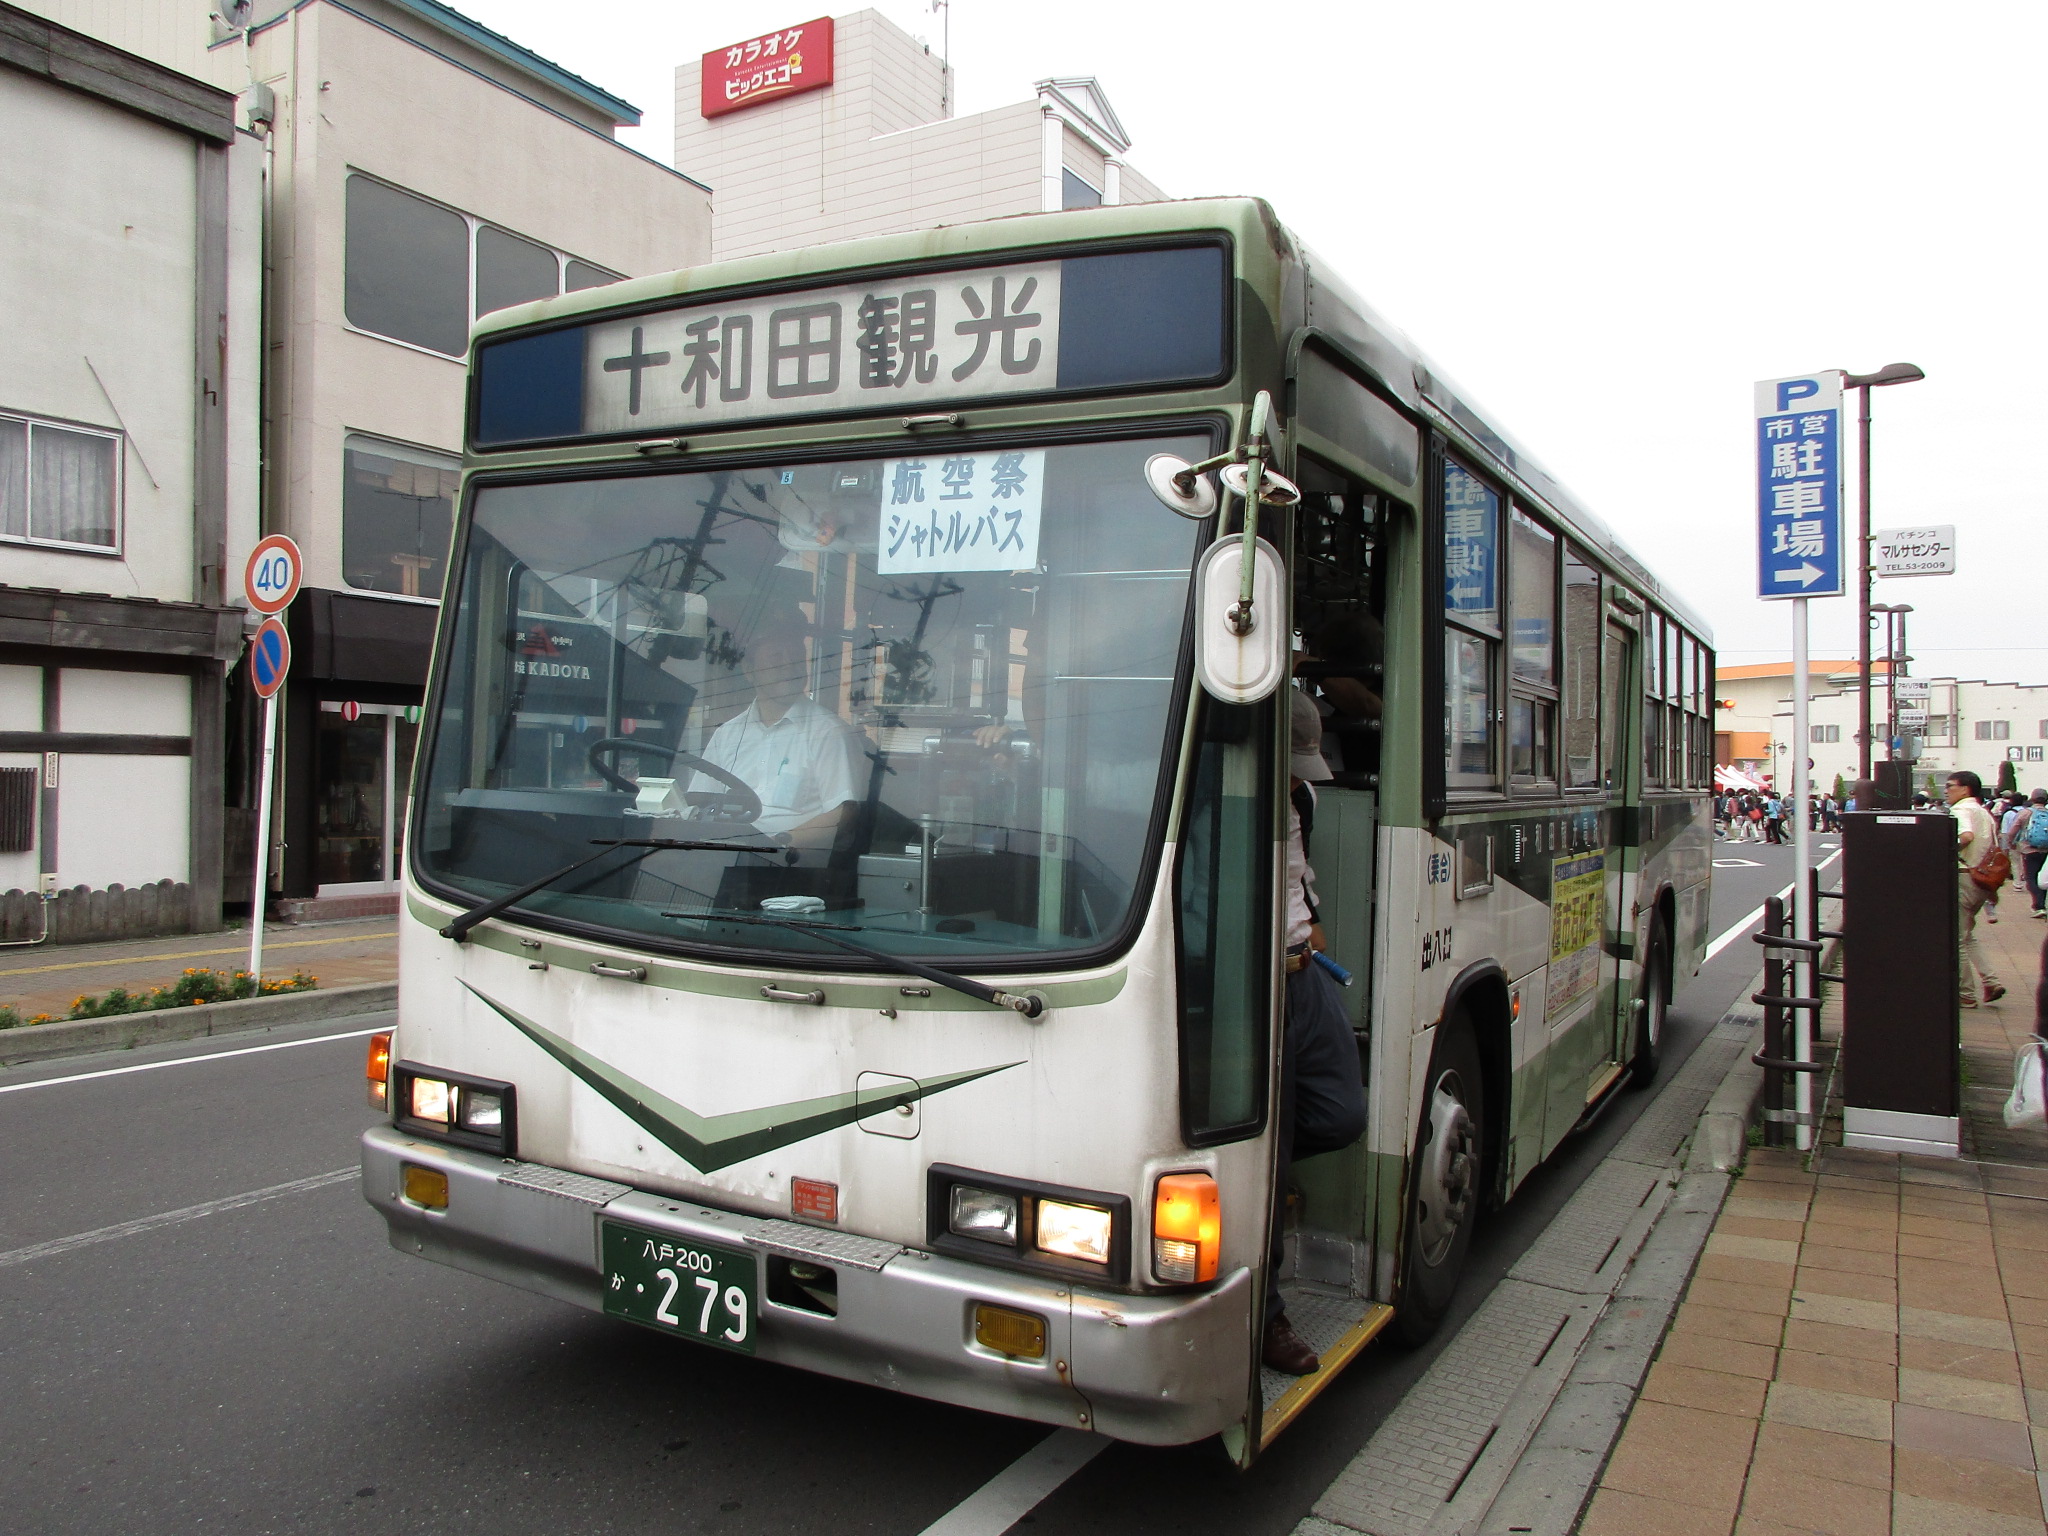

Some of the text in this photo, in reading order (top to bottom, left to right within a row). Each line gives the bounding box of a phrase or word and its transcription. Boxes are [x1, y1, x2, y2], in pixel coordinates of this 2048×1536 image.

[725, 30, 803, 69] カラオケ
[725, 64, 803, 100] ビッグエコー
[603, 276, 1042, 416] 十和田観光
[1777, 379, 1820, 413] P
[1766, 415, 1827, 439] 市営
[891, 452, 1028, 505] 航空祭
[1771, 439, 1825, 557] 駐車場
[887, 505, 1024, 559] シャトルバス
[1881, 543, 1950, 559] マルサセンター
[257, 556, 288, 591] 40
[528, 661, 590, 680] KADOYA
[1421, 926, 1452, 972] 出入口
[611, 1272, 626, 1291] か
